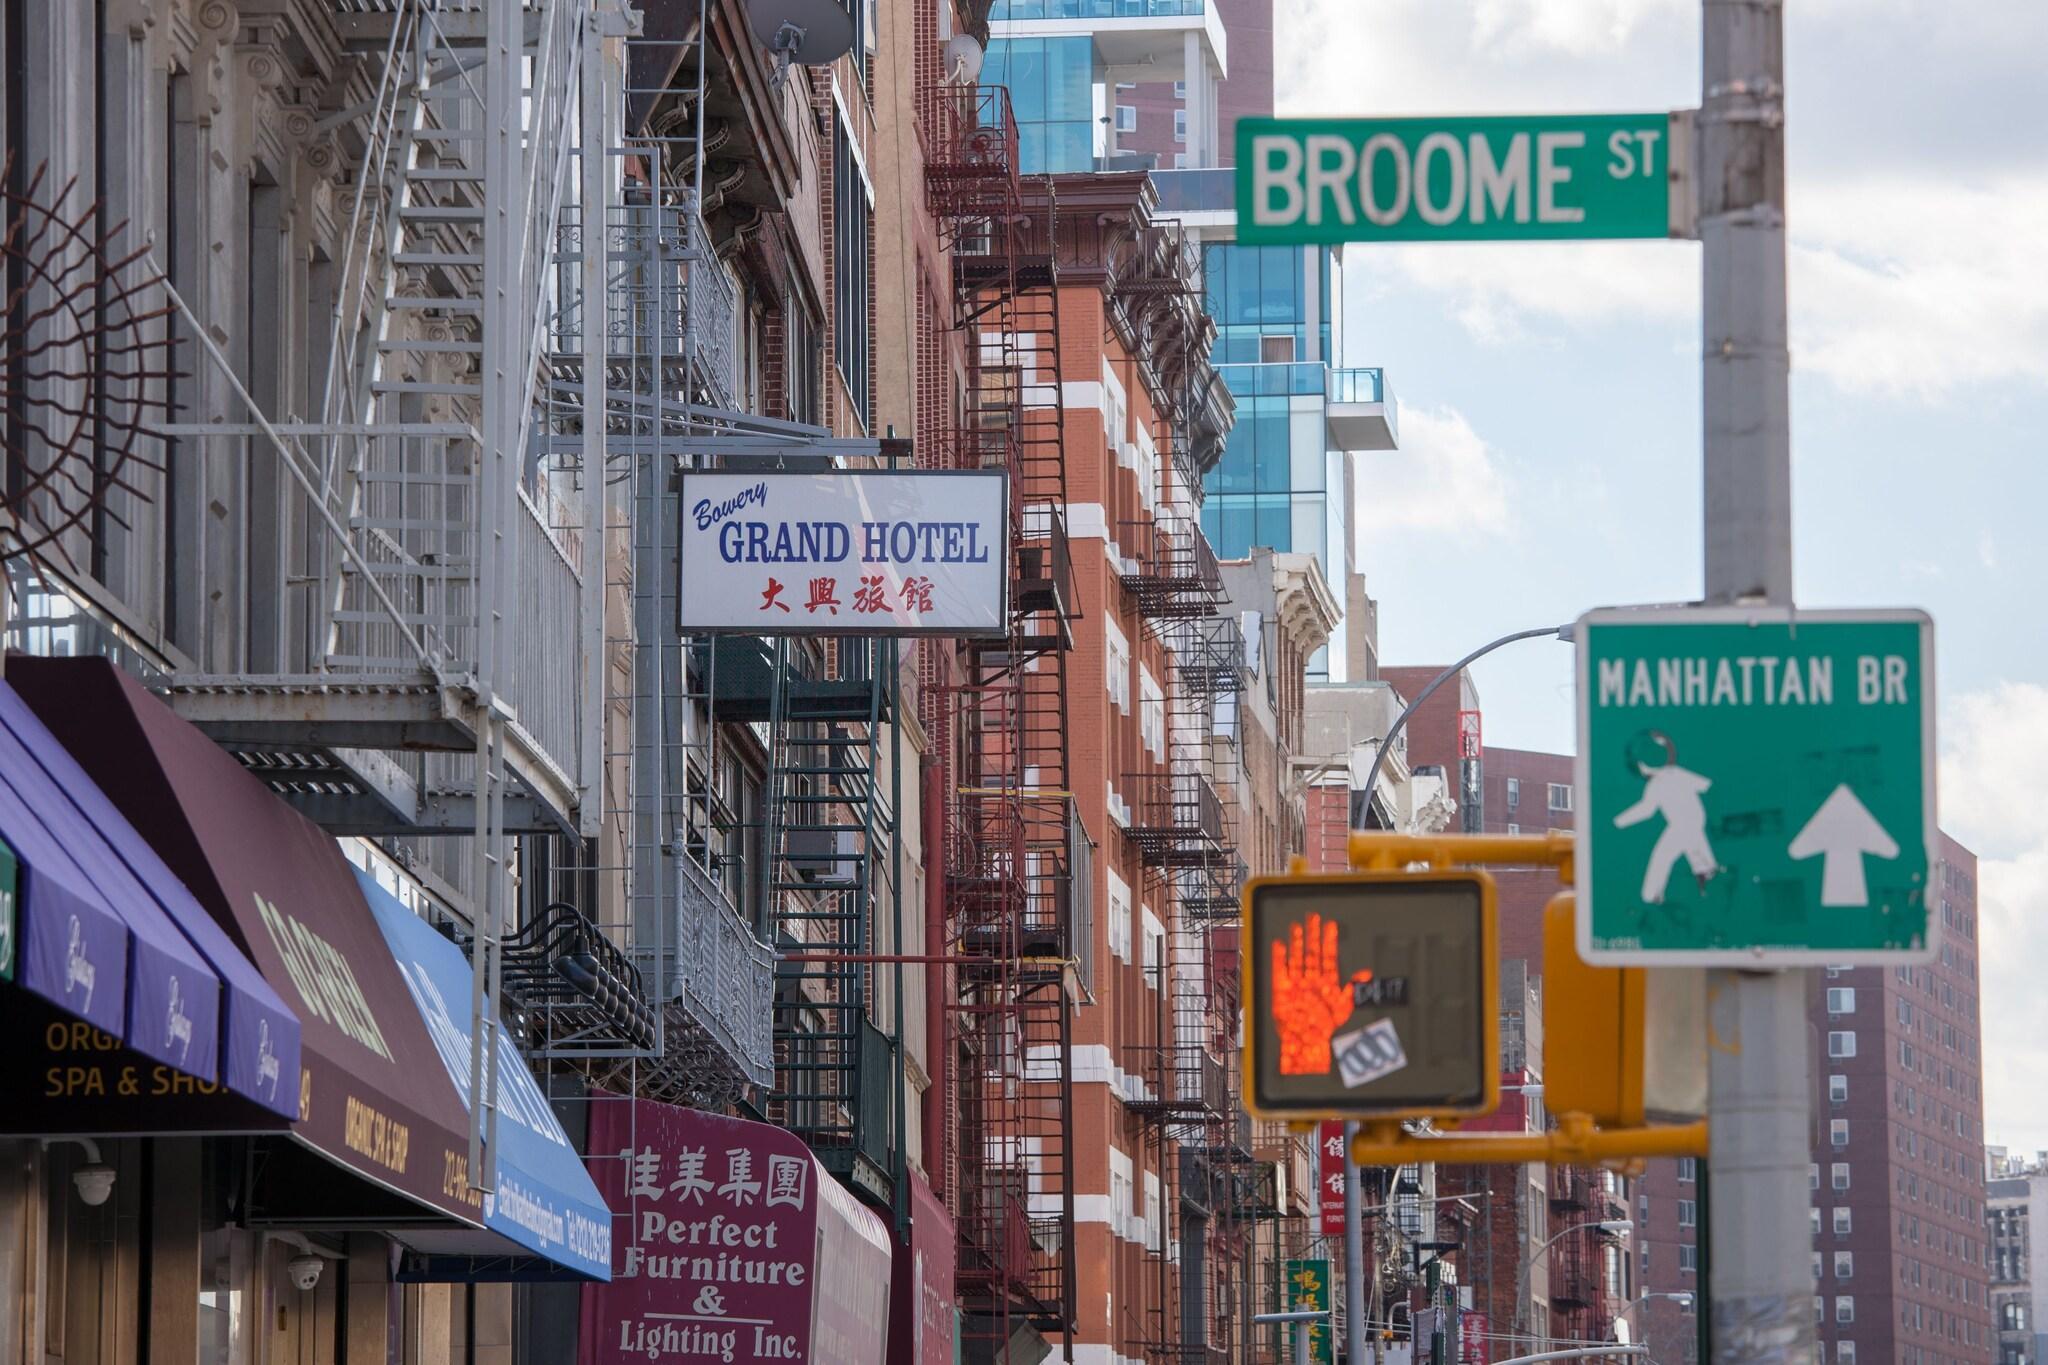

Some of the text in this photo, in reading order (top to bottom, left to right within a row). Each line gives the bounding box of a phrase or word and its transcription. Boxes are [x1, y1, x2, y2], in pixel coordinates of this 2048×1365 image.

[1253, 130, 1661, 227] BROOME ST
[692, 481, 768, 531] Bowery
[719, 521, 988, 563] GRAND HOTEL
[760, 575, 935, 615] 大興旅館
[1599, 655, 1908, 707] MANHATTAN BR
[46, 1066, 229, 1096] SPA & SHO
[620, 1145, 808, 1212] 佳美集團
[640, 1211, 778, 1249] Perfect
[624, 1247, 805, 1286] Furniture
[692, 1286, 727, 1315] &
[619, 1320, 802, 1363] Lighting Inc.
